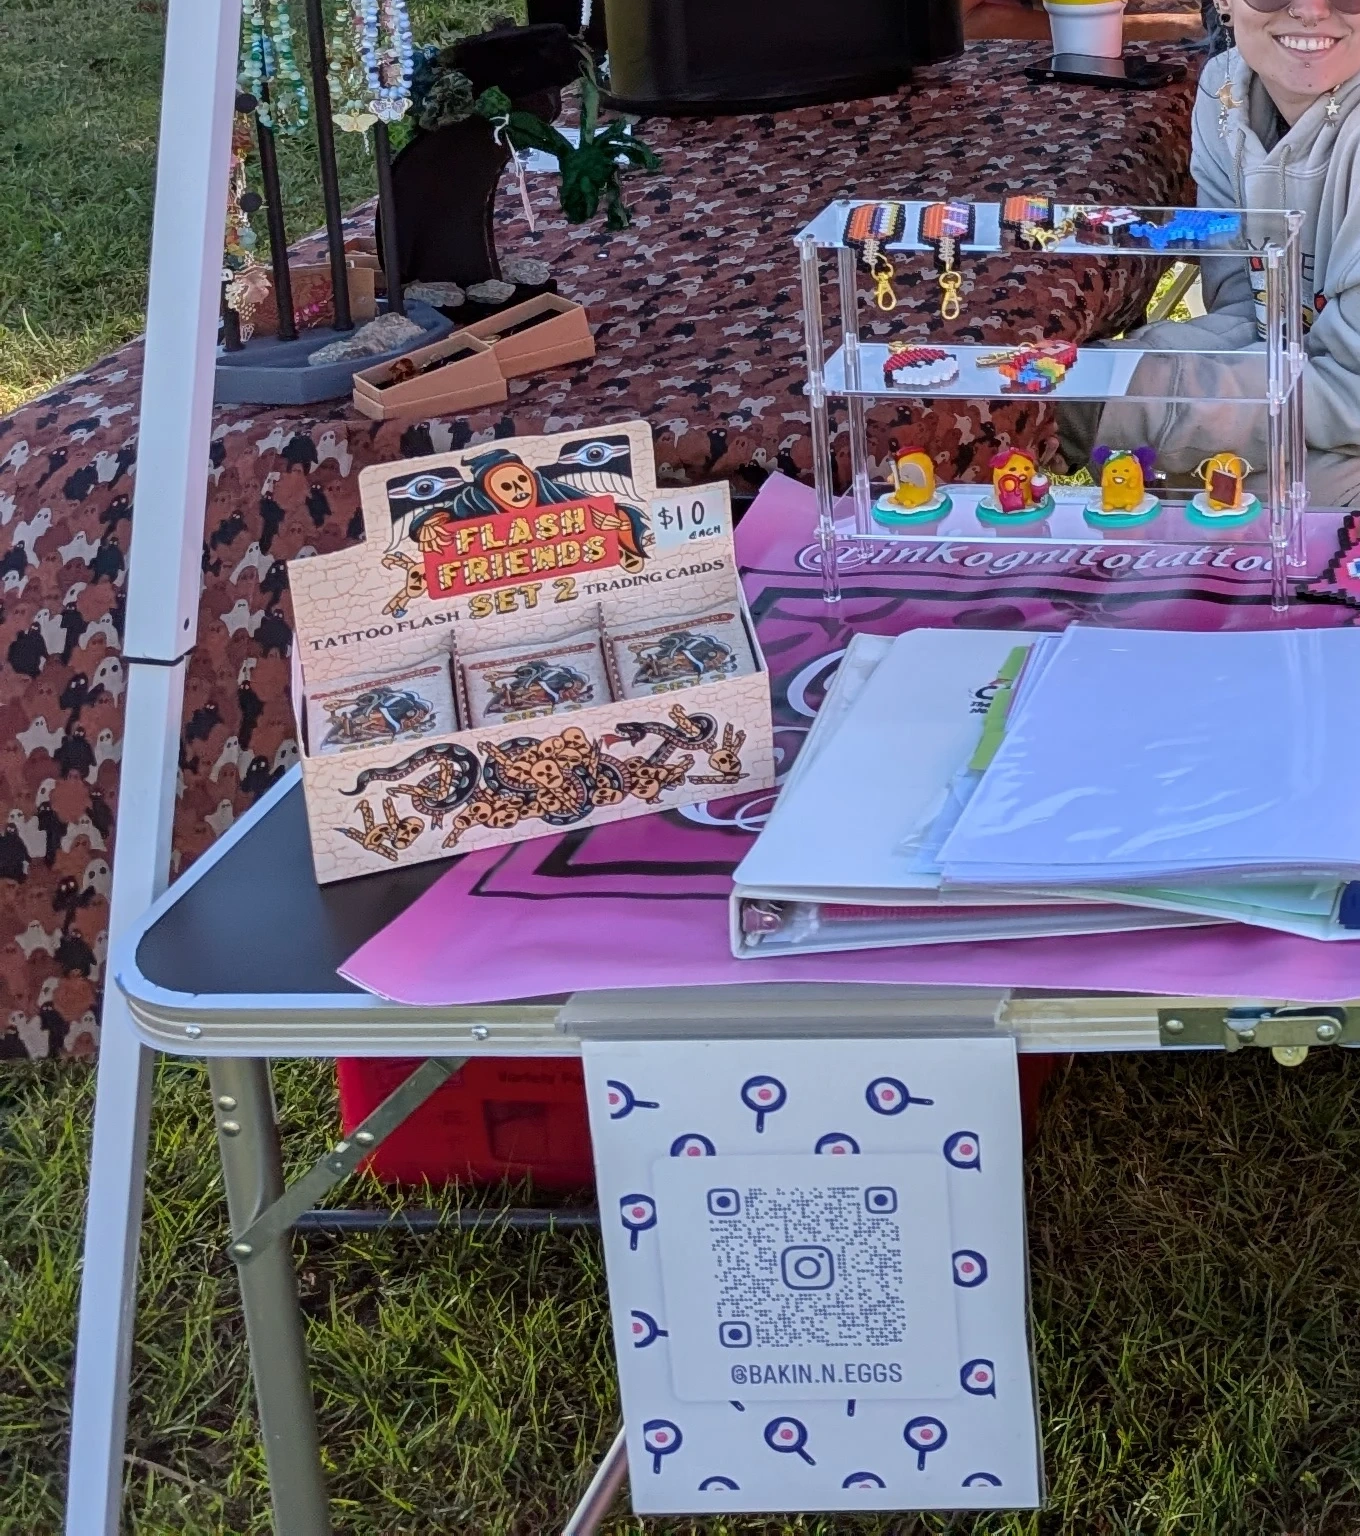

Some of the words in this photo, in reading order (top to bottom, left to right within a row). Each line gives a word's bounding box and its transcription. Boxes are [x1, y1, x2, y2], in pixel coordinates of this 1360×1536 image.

[455, 506, 586, 555] FLASH
[657, 500, 705, 531] $10
[437, 536, 607, 592] FRIENDS
[309, 624, 393, 652] TATTOO
[397, 610, 460, 634] FLASH
[468, 583, 541, 620] SET
[553, 577, 580, 605] 2
[583, 571, 664, 595] TRADING
[665, 558, 725, 580] CARDS
[730, 1362, 903, 1385] @BAKIN.N.EGGS
